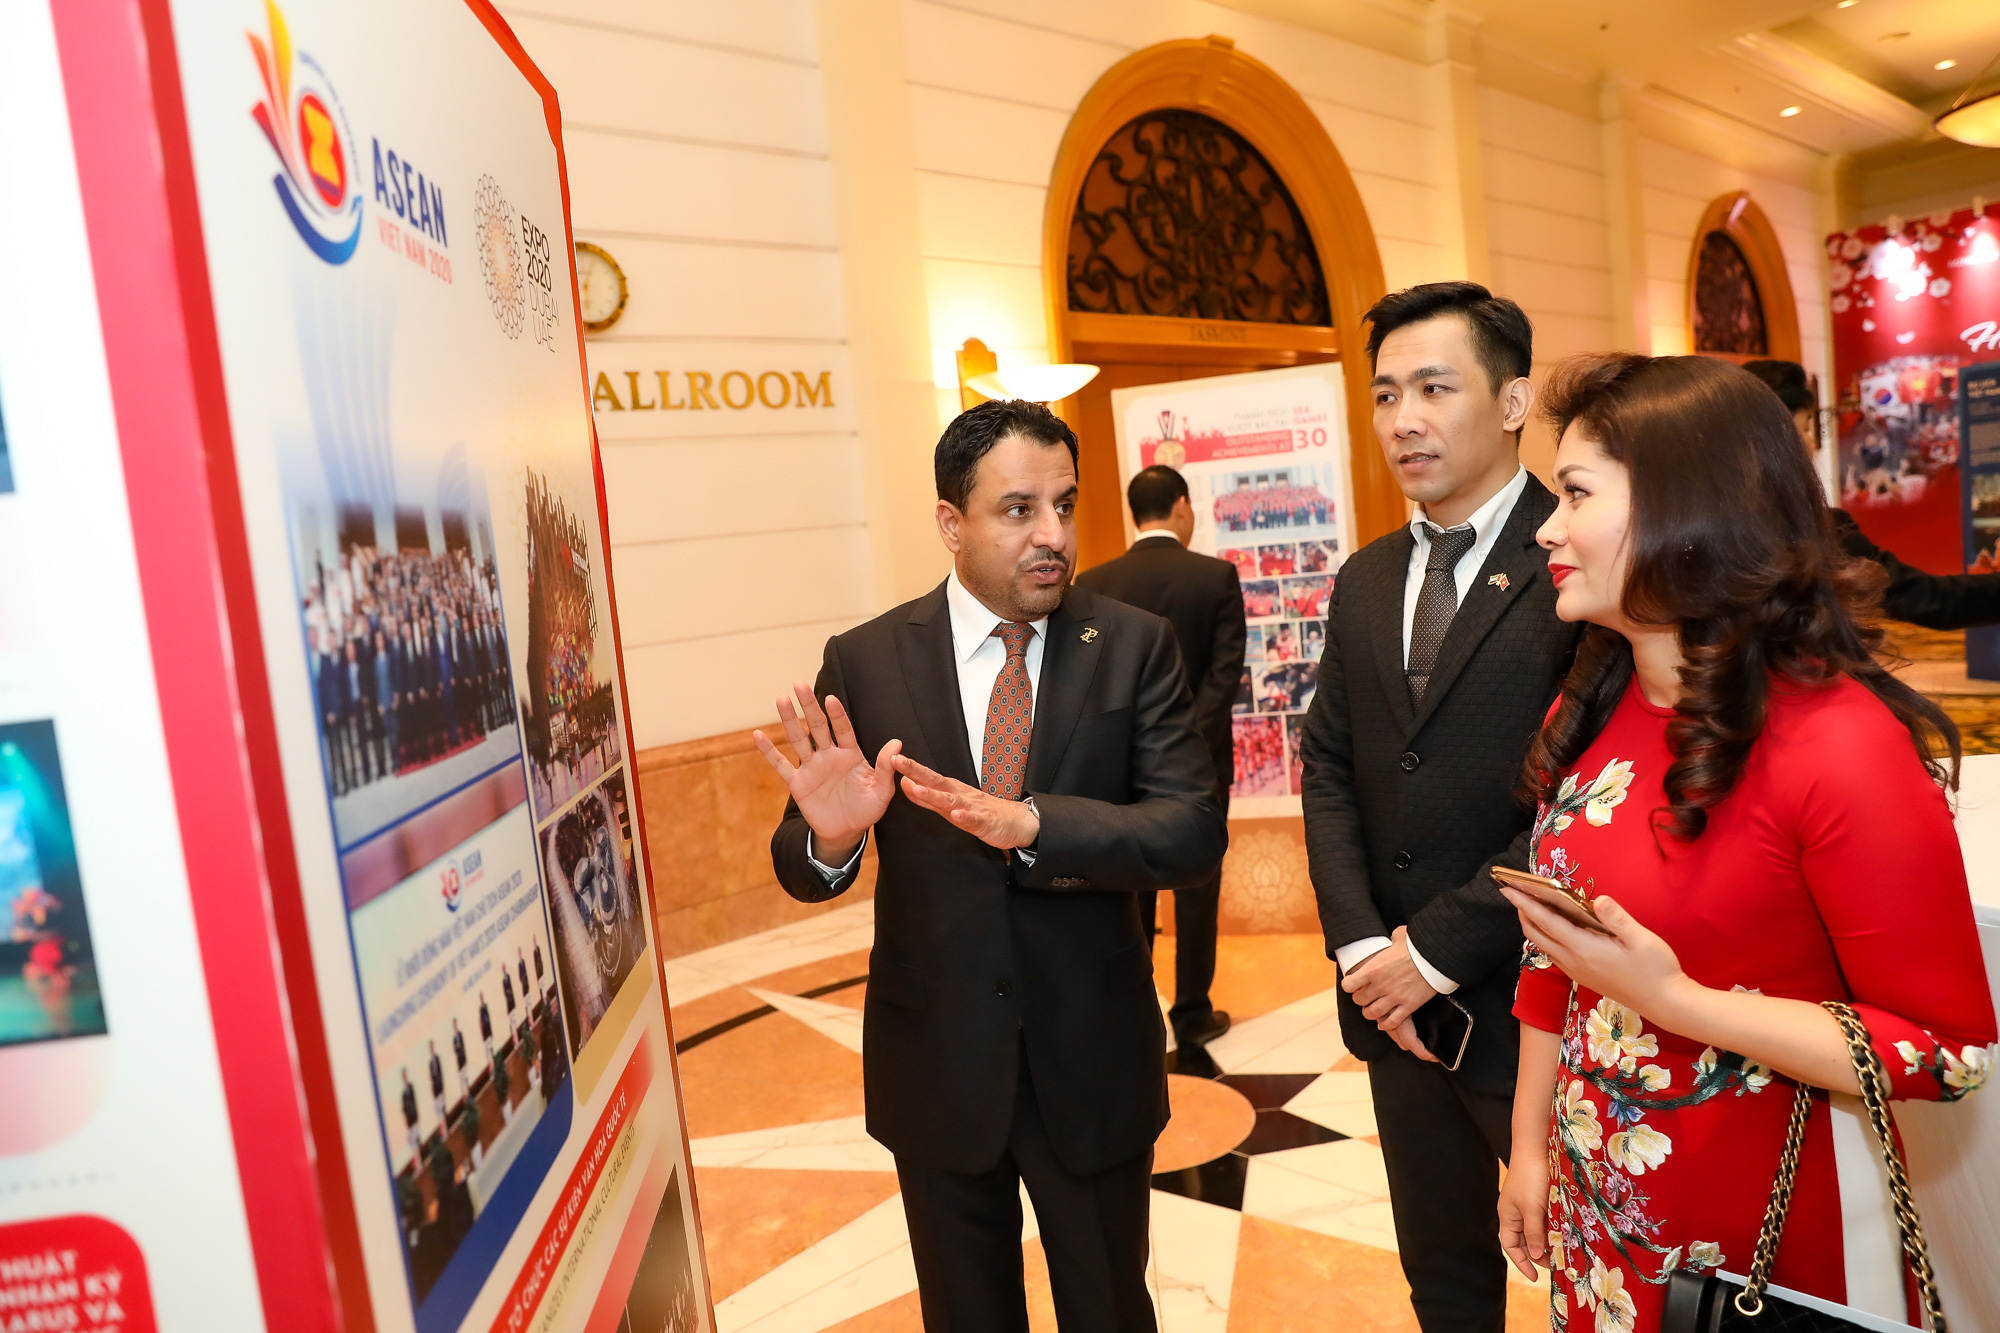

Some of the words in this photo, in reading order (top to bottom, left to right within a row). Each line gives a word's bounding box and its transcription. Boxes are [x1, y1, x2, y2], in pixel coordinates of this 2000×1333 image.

[371, 132, 449, 249] ASEAN
[403, 230, 428, 270] NAM
[428, 247, 454, 285] 2020
[521, 214, 550, 262] EXPO
[525, 248, 552, 293] 2020
[528, 280, 560, 327] DUBAI
[532, 313, 556, 353] UAE
[1293, 413, 1328, 425] GAMES
[1295, 427, 1328, 449] 30
